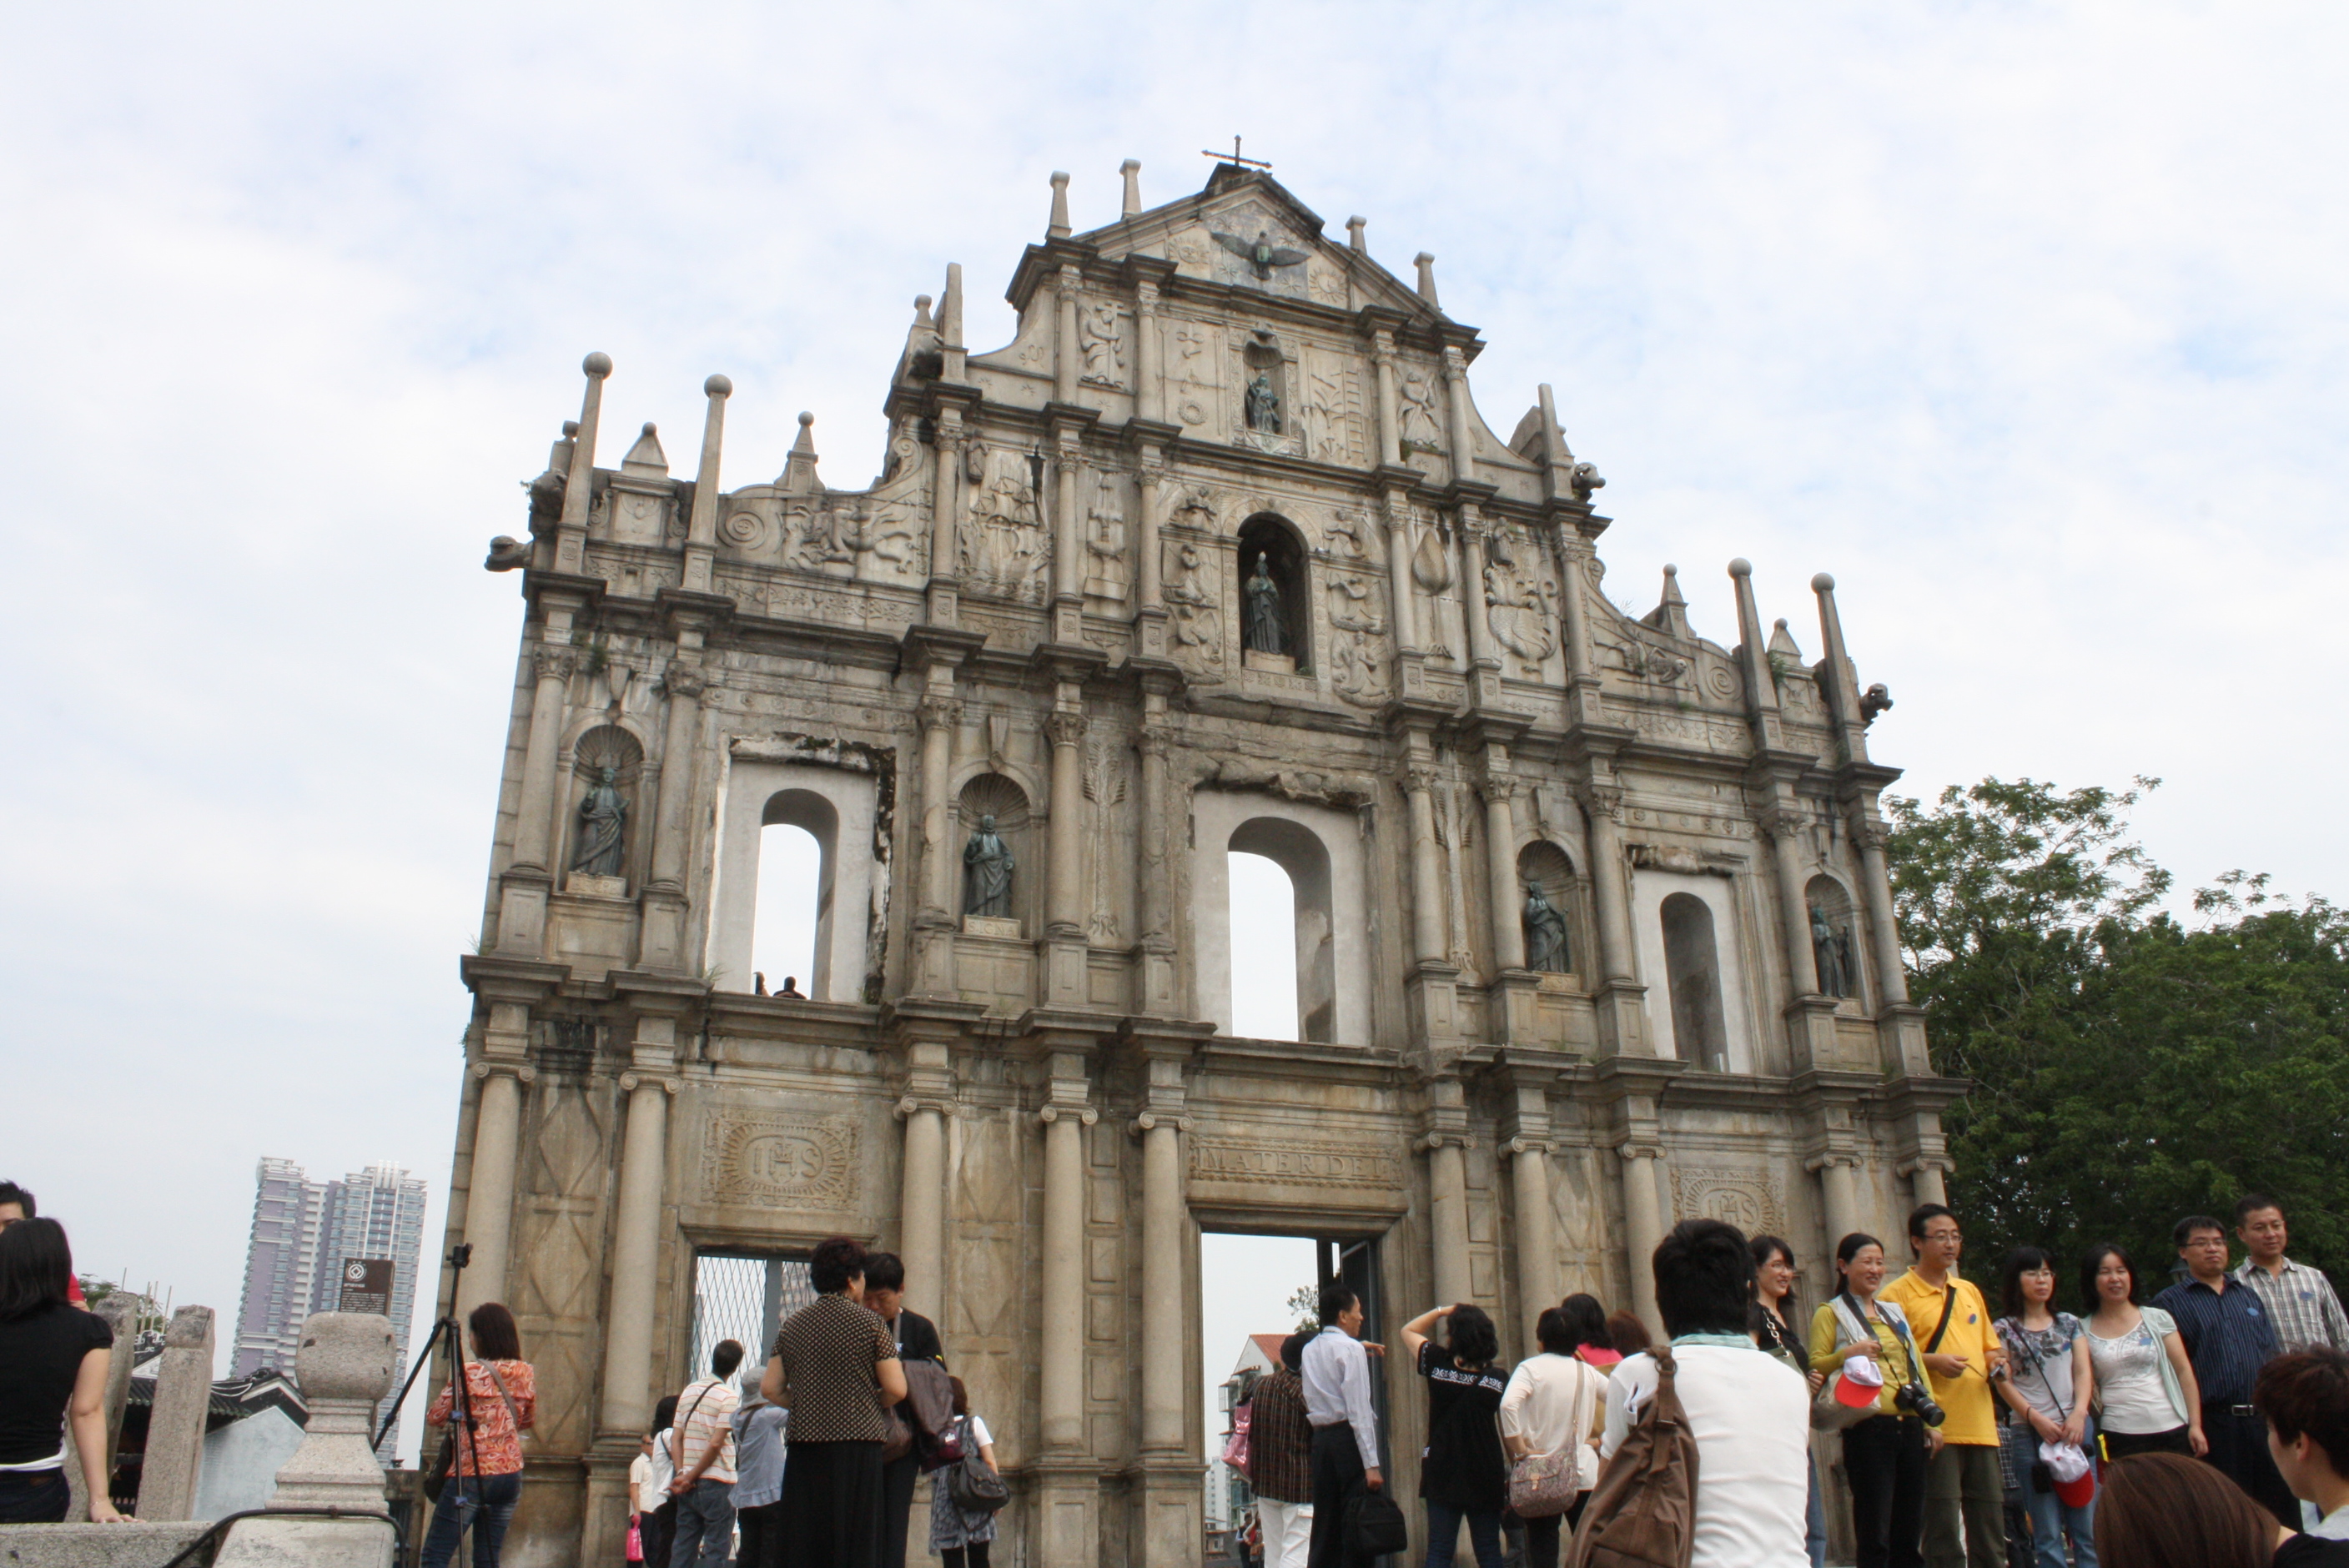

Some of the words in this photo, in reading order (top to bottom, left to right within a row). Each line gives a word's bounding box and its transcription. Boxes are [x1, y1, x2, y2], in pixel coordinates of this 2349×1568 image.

[753, 1146, 820, 1179] IHS
[1200, 1148, 1315, 1175] MATER
[1326, 1156, 1382, 1179] DEI
[1708, 1196, 1756, 1225] IHS
